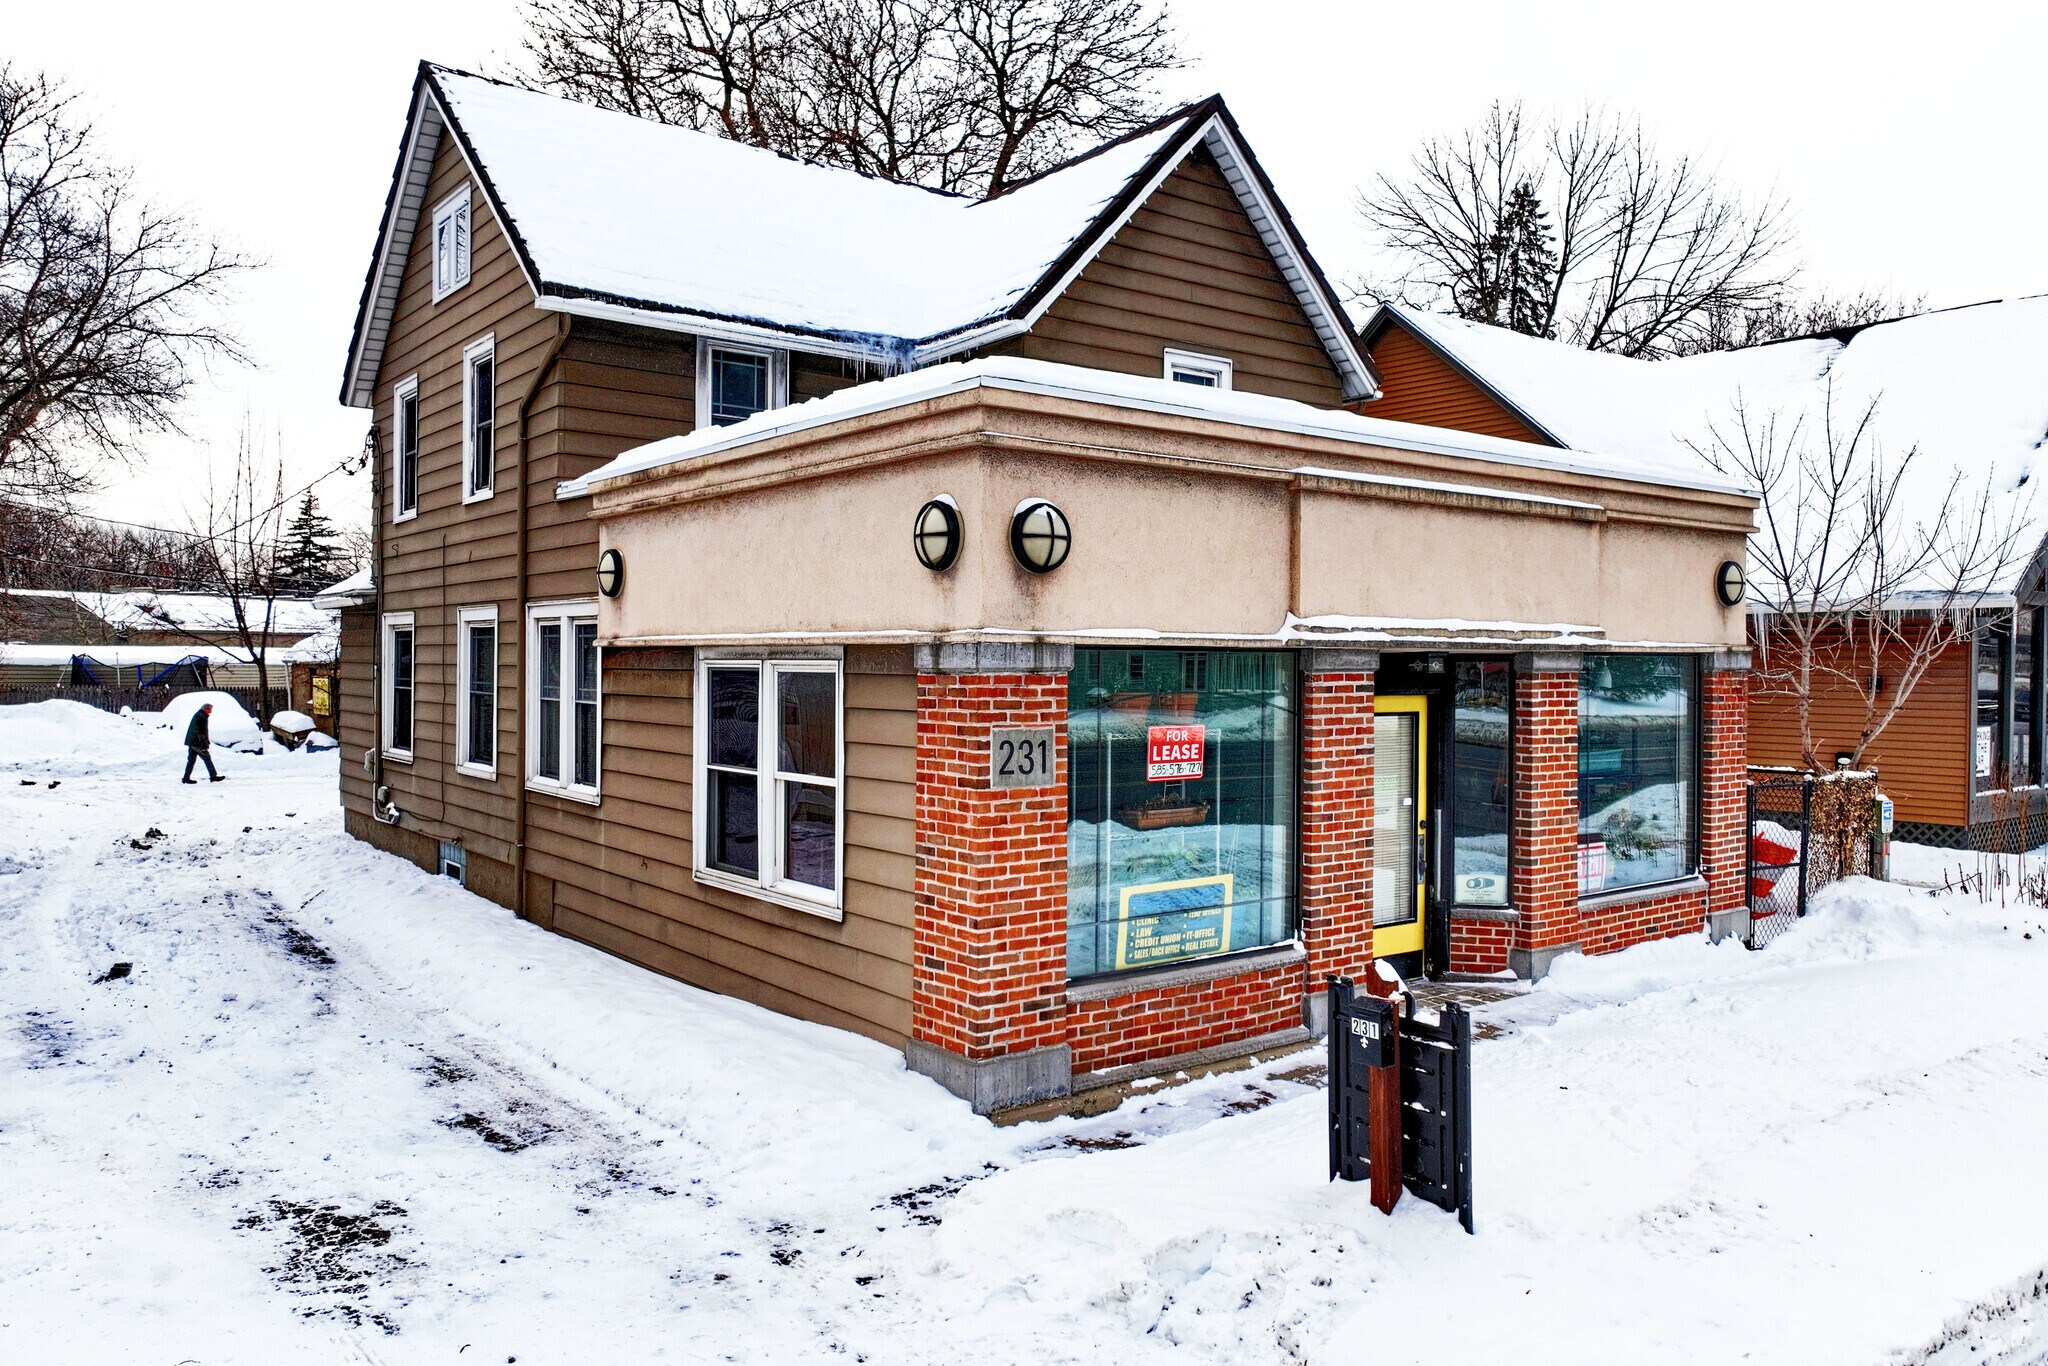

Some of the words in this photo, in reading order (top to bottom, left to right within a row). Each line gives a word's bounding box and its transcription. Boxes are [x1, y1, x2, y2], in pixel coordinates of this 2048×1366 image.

[1166, 730, 1189, 742] FOR
[999, 740, 1047, 775] 231
[1153, 743, 1200, 761] LEASE
[1136, 927, 1152, 938] LAW
[1135, 937, 1159, 948] CREDIT
[1160, 933, 1181, 945] UNION
[1186, 941, 1199, 951] REAL
[1200, 938, 1219, 949] ESTATE
[1165, 944, 1180, 955] OFFICE
[1353, 1020, 1377, 1037] 231
